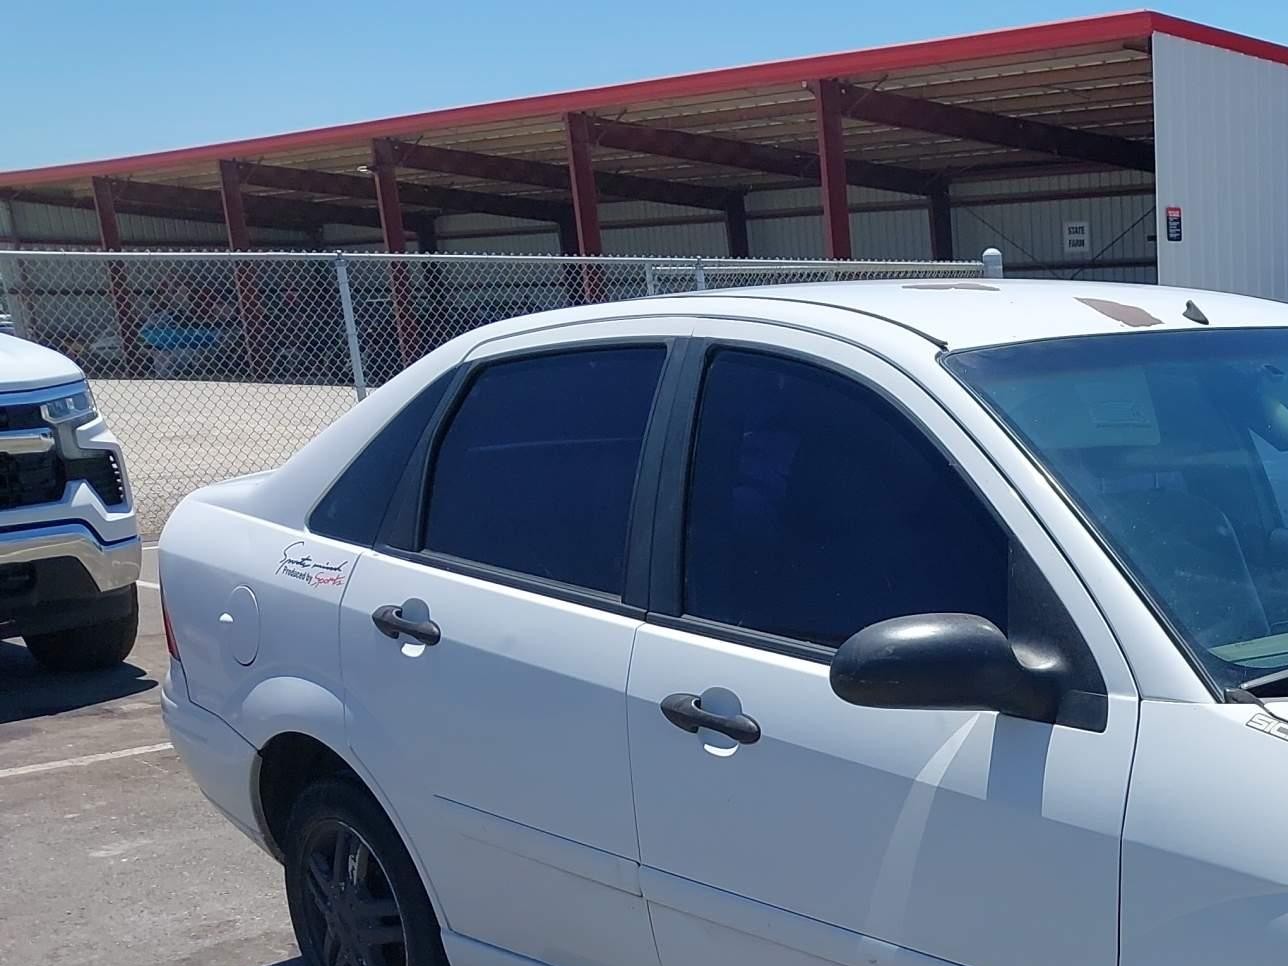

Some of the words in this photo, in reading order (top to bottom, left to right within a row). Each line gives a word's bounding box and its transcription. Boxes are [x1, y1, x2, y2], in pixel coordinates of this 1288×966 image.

[1068, 226, 1085, 235] STATE
[1068, 239, 1085, 248] FARM
[282, 565, 307, 581] Produced
[305, 572, 314, 585] by
[311, 571, 346, 588] Sports
